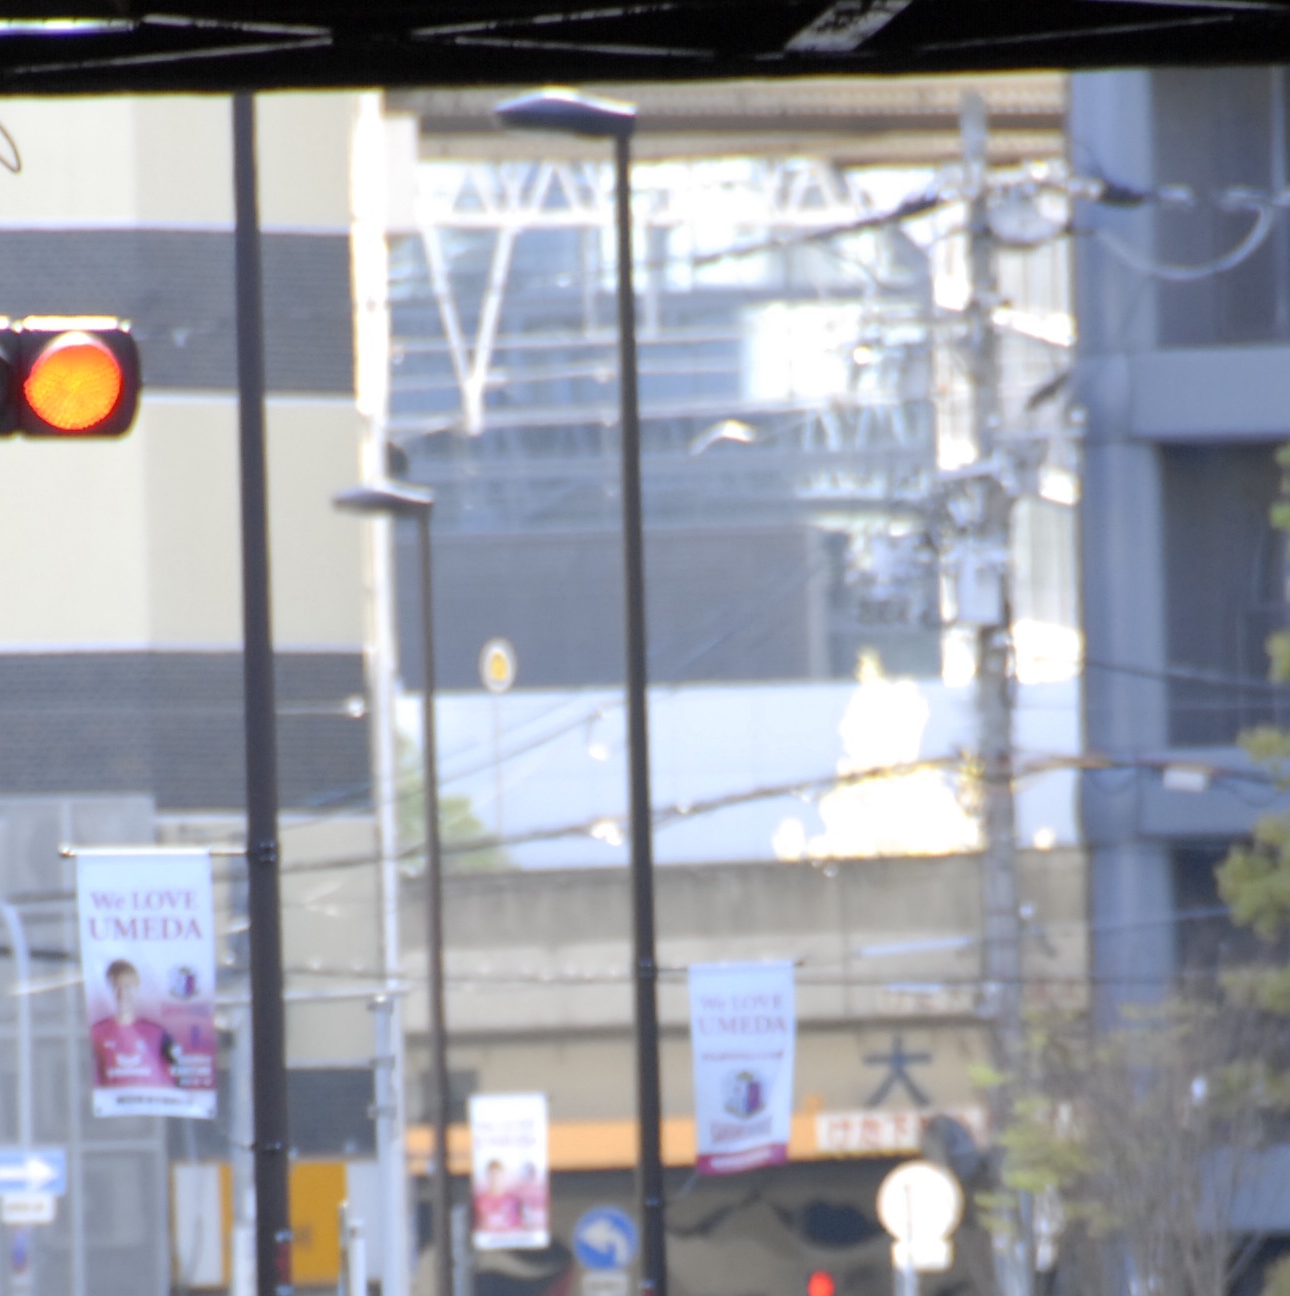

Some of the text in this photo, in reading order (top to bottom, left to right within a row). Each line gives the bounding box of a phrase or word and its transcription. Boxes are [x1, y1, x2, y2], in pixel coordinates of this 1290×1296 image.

[90, 889, 199, 911] We LOVE
[87, 916, 203, 941] UMEDA
[698, 1016, 787, 1036] UMEDA
